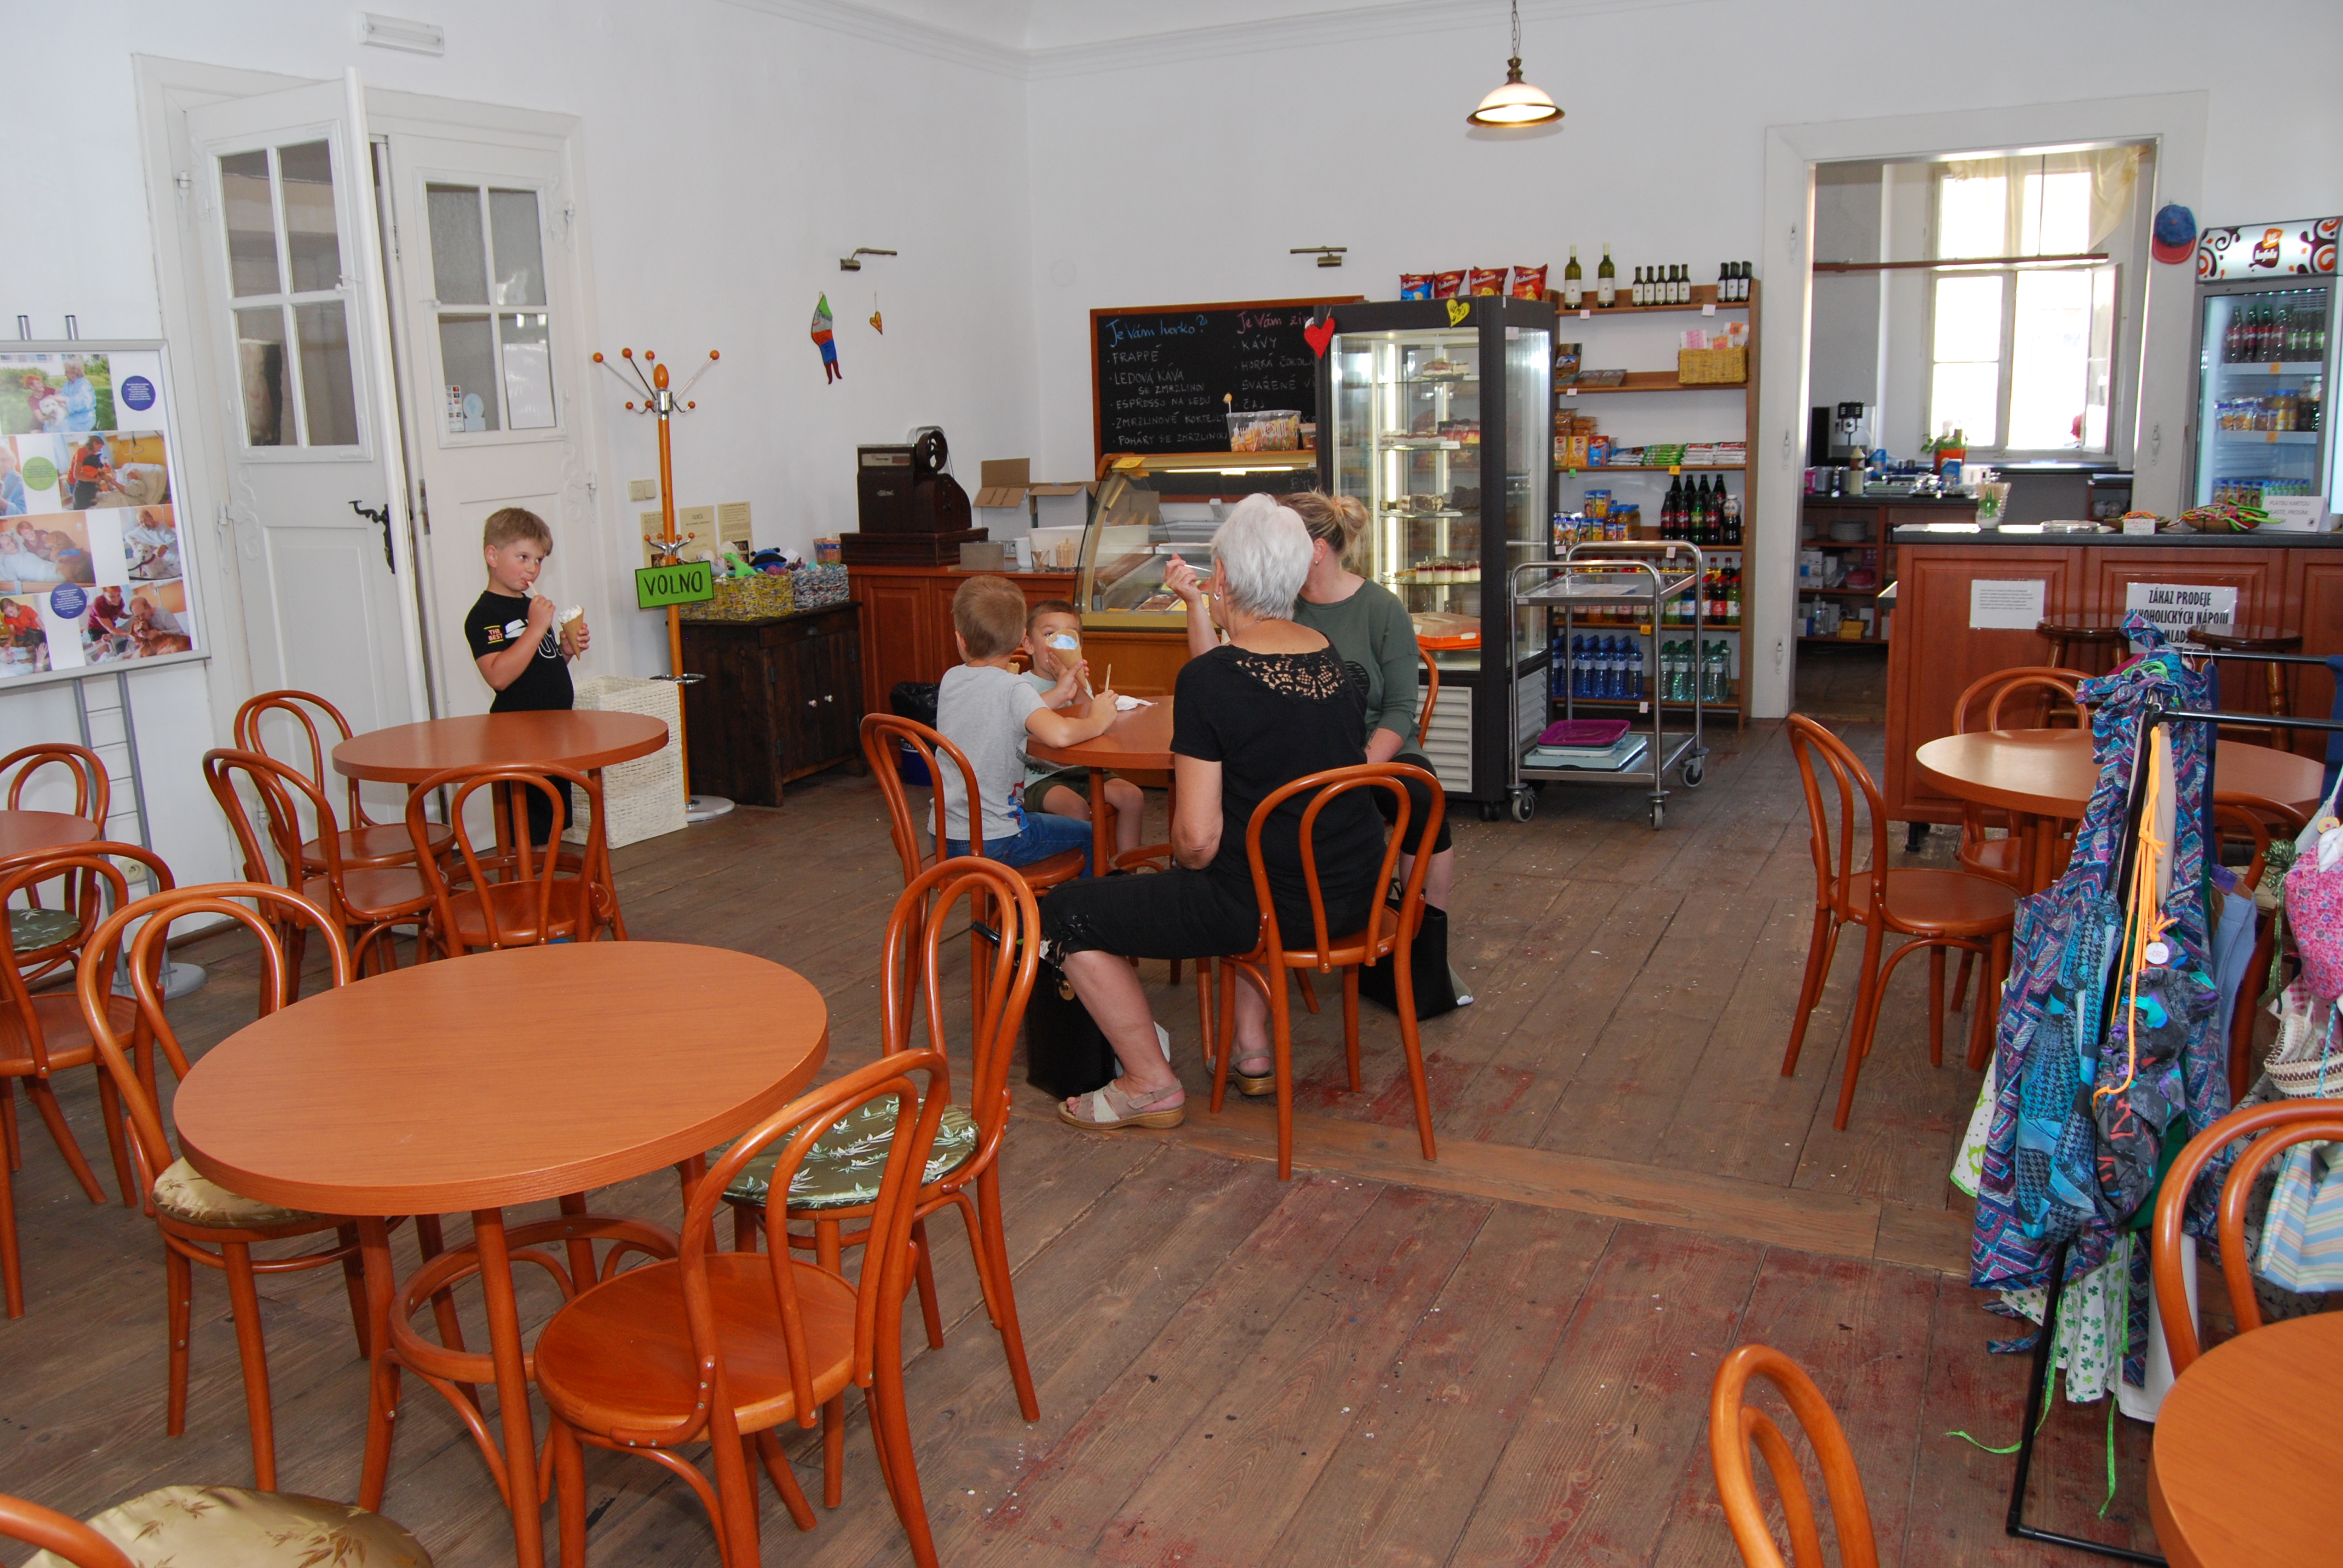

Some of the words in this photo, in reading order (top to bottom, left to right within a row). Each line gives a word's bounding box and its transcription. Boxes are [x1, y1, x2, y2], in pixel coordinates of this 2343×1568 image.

[1402, 280, 1424, 289] Bohemia
[1438, 279, 1461, 290] Bohemia
[1471, 274, 1496, 285] Bohemia
[1515, 273, 1540, 284] Bohemia
[1237, 310, 1253, 334] Je
[1254, 312, 1282, 328] Vám
[1106, 319, 1124, 347] Je
[1125, 322, 1155, 339] Vám
[1242, 334, 1277, 351] KÁVY
[1112, 344, 1162, 364] FRAPPÉ
[1242, 352, 1274, 371] HORKÁ
[1114, 368, 1153, 385] LEDOVÁ
[1157, 362, 1184, 382] KÁVA
[1242, 373, 1297, 391] SVAŘENÉ
[1138, 386, 1150, 395] SE
[1116, 397, 1165, 410] ESPRESSO
[1172, 397, 1185, 406] NA
[1188, 396, 1211, 406] LEDU
[1243, 398, 1265, 410] ČAJ
[1116, 411, 1180, 429] ZMRZLINOVÉ
[1185, 413, 1227, 423] KOKTEJLY
[1118, 431, 1154, 446] POHÁRY
[1159, 434, 1172, 443] SE
[644, 571, 703, 596] VOLNO
[2149, 587, 2174, 604] ZÁKAZ
[2176, 591, 2212, 607] PRODEJE
[2135, 607, 2193, 624] KOHOLICKÝCH
